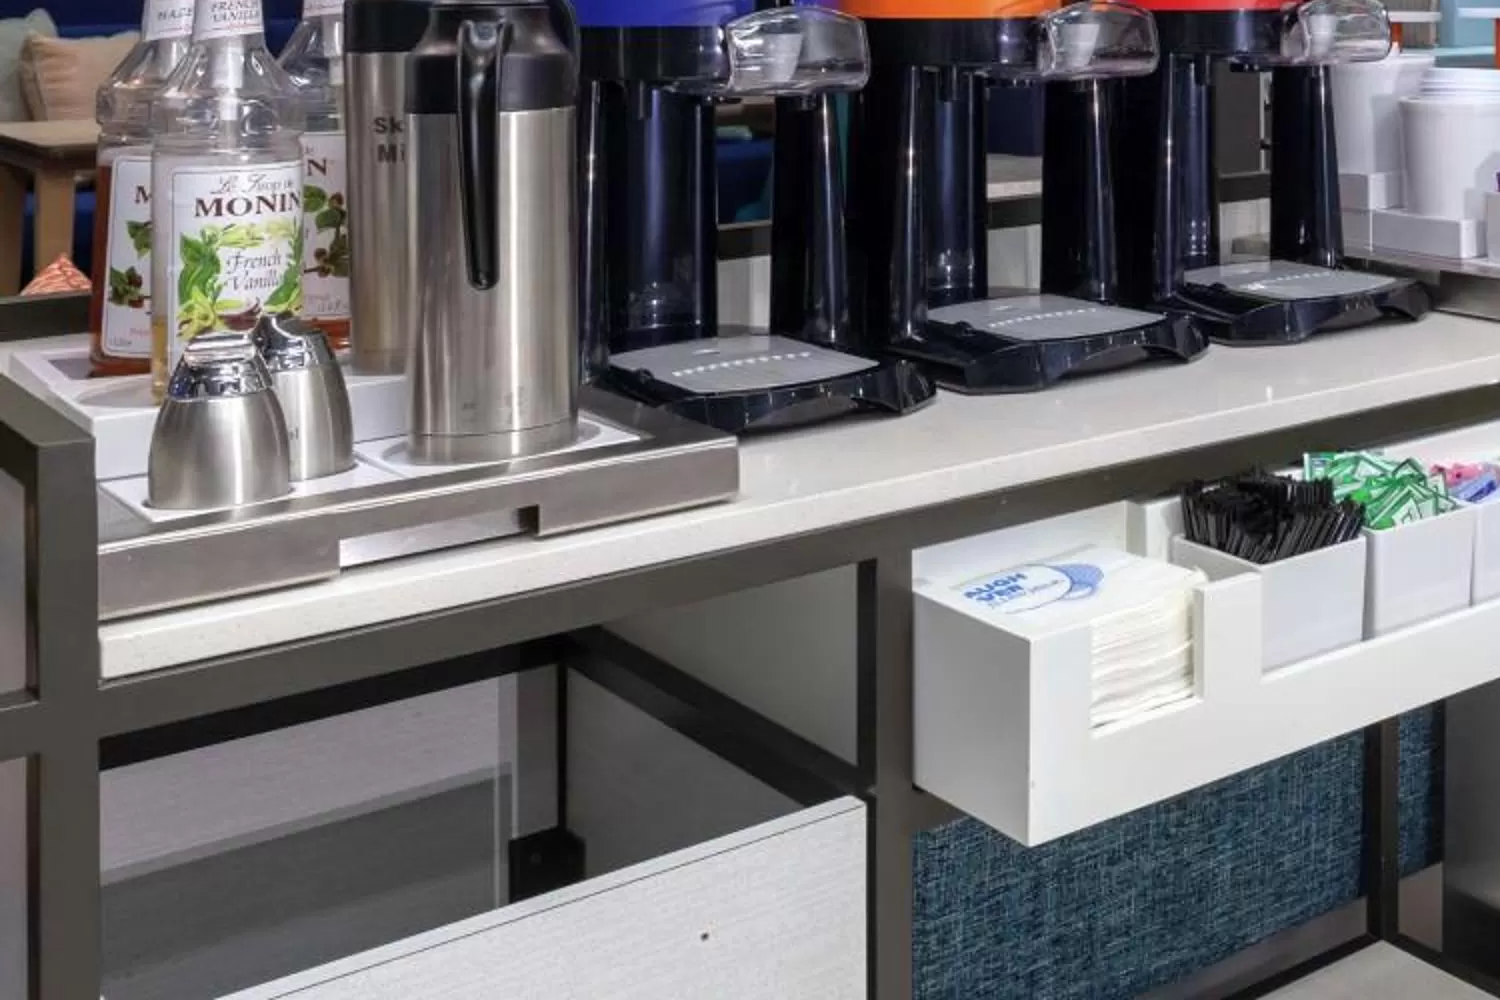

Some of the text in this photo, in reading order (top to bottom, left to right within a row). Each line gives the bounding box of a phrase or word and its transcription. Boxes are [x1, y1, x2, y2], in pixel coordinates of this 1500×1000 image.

[374, 116, 404, 134] Sk
[195, 191, 301, 217] MONIN
[224, 247, 282, 276] French
